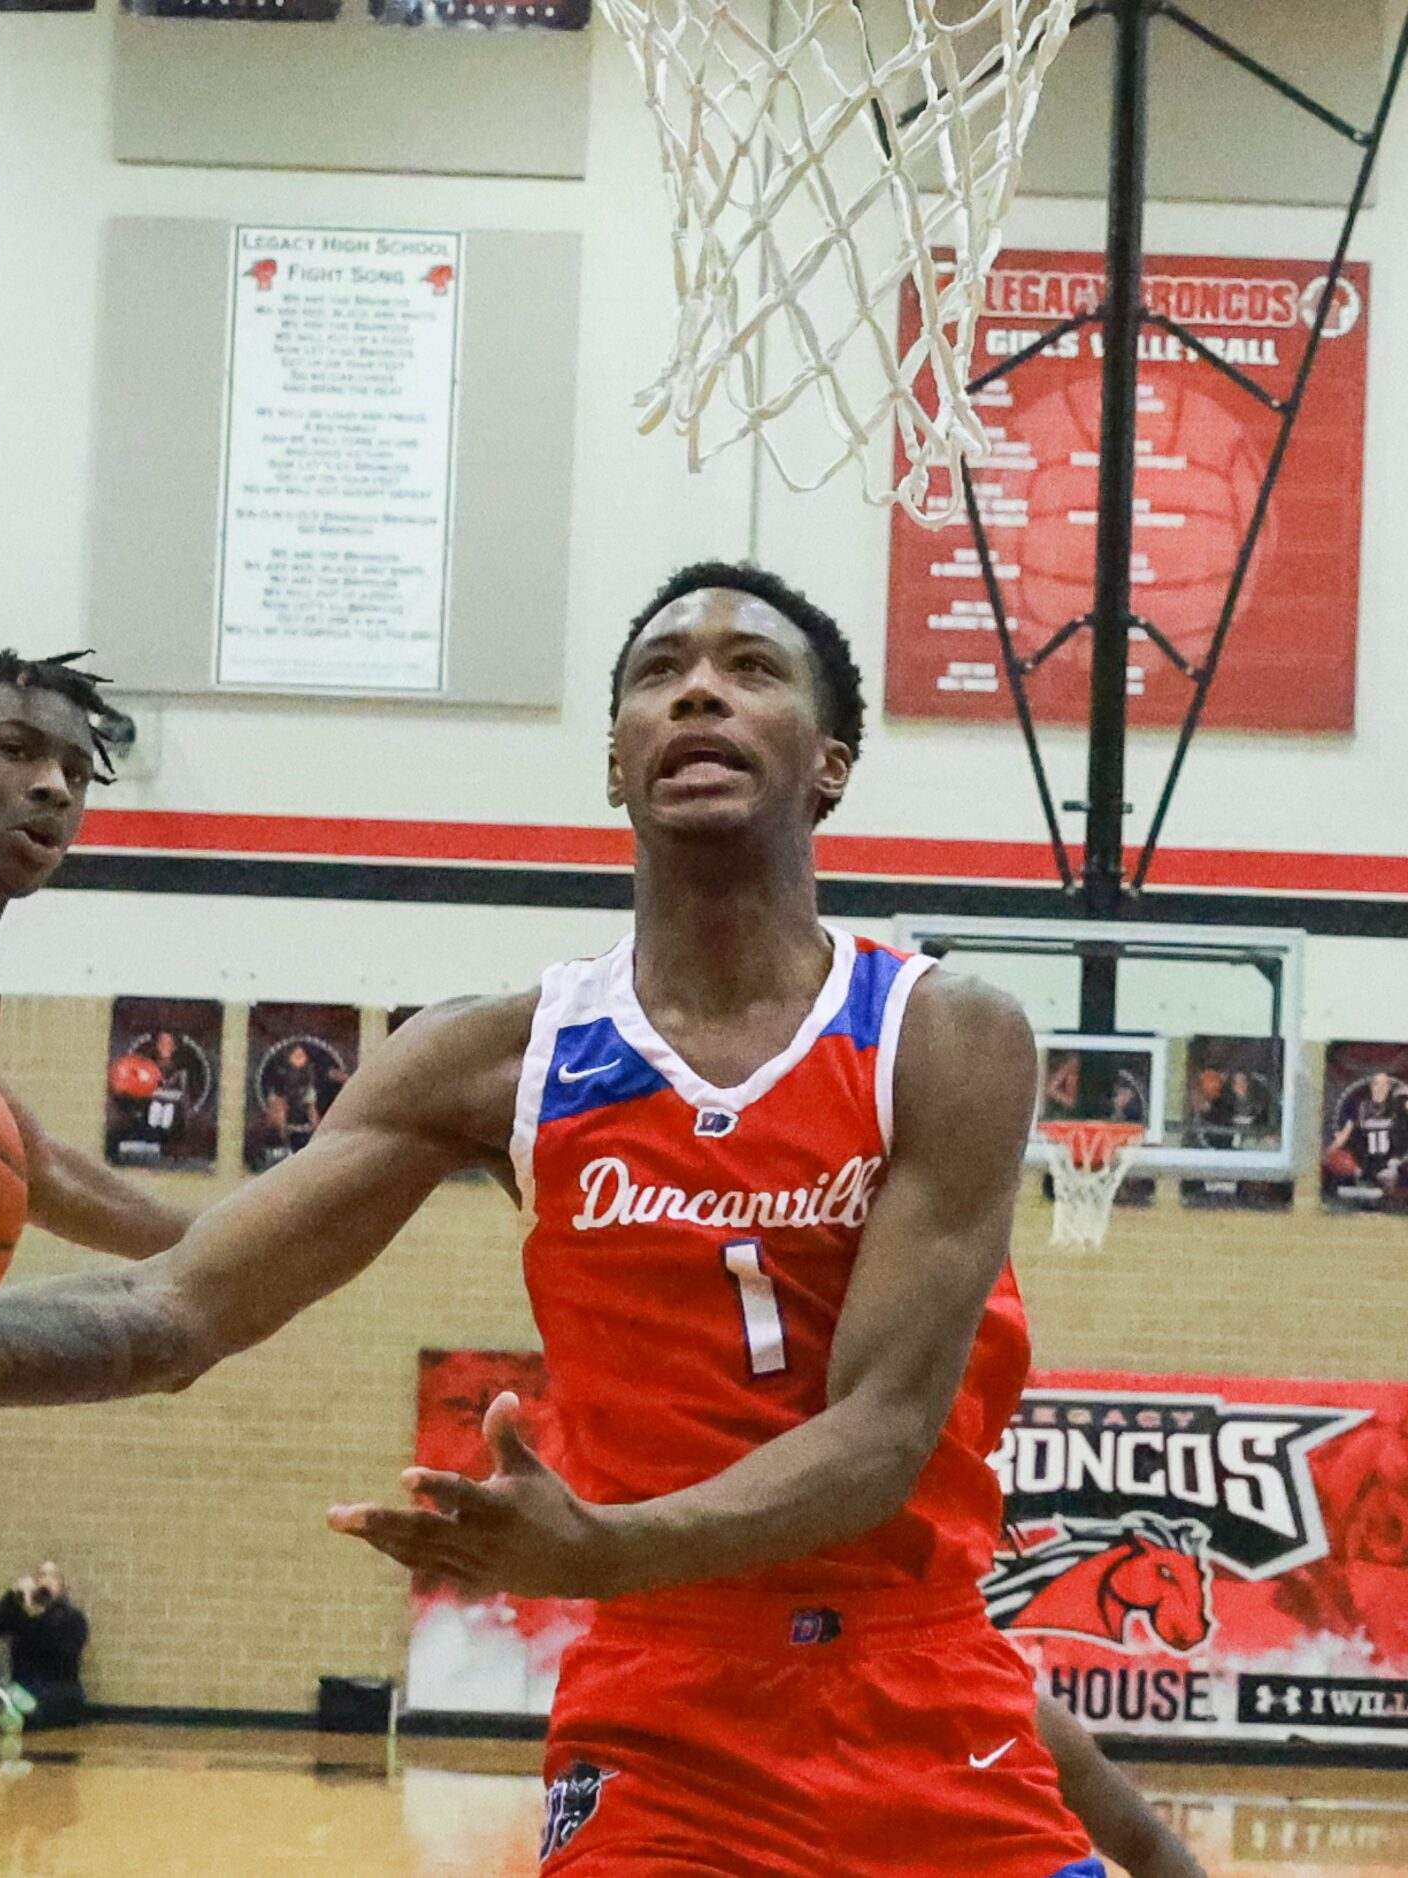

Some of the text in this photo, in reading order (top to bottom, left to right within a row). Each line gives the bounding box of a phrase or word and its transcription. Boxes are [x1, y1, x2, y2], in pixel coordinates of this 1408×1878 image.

[243, 234, 448, 256] LEGACY HIGH SCHOOL
[288, 264, 405, 285] FIGHT SONG
[1141, 275, 1299, 327] RONCOS
[721, 1237, 789, 1379] 1
[984, 1420, 1302, 1539] RONCOS
[1051, 1667, 1214, 1722] HOUSE
